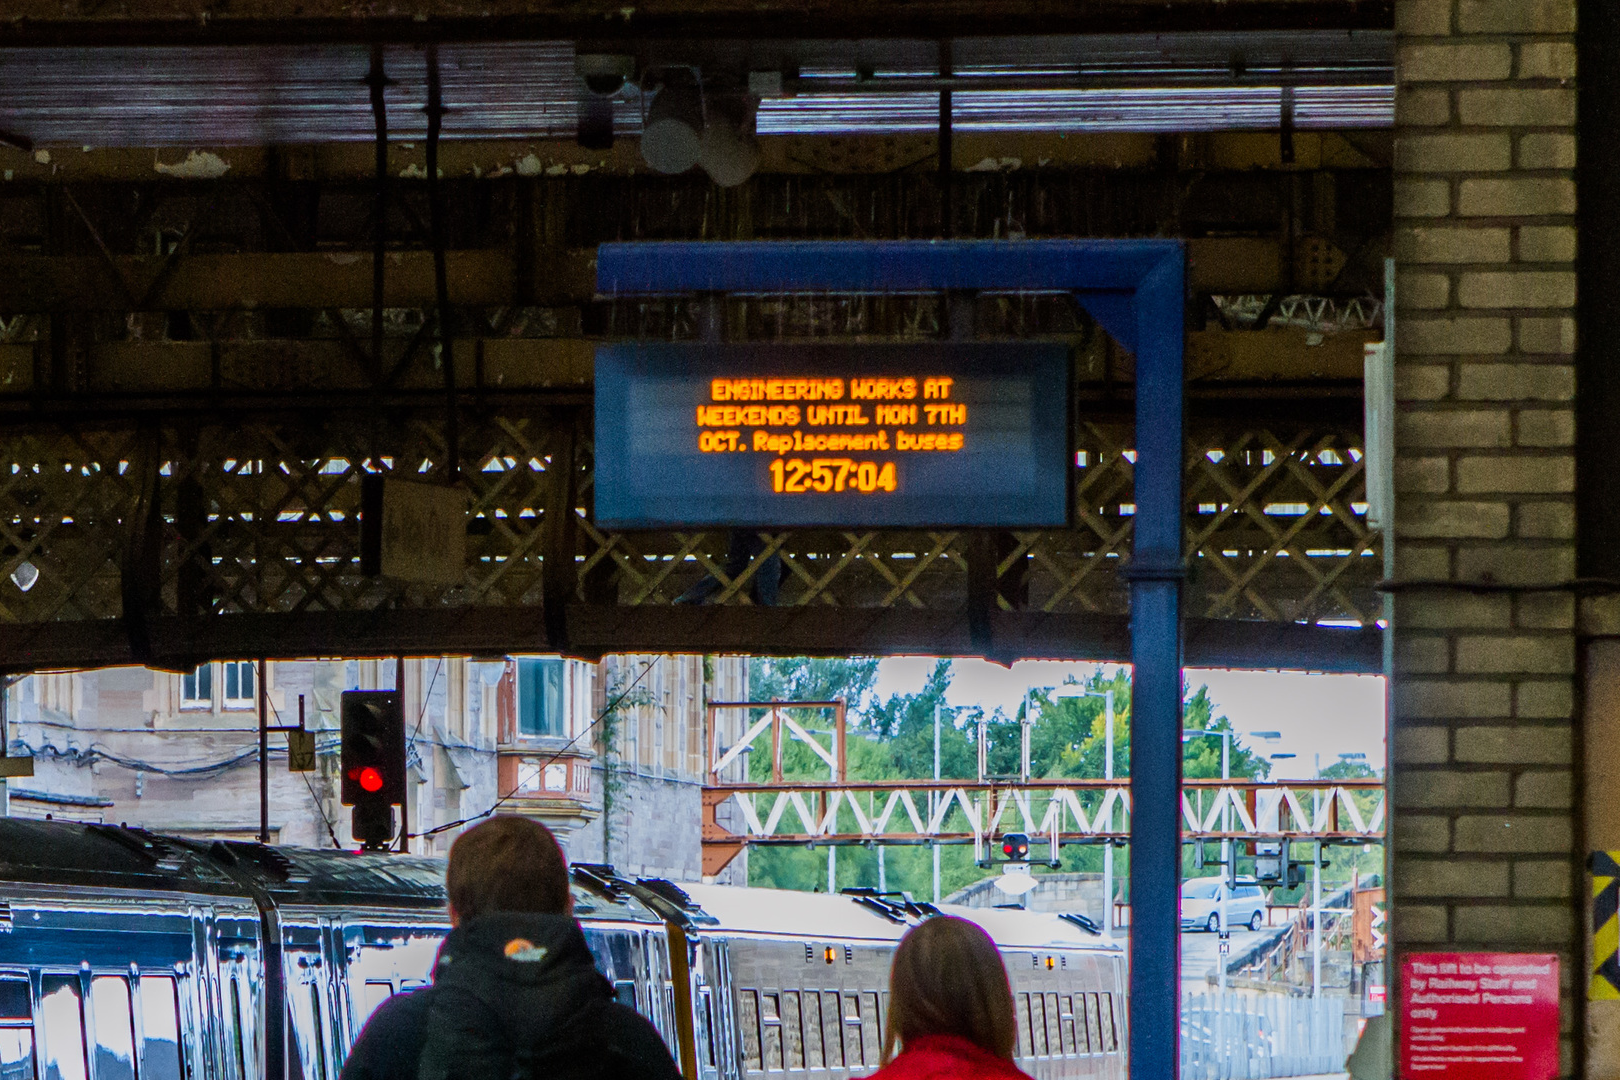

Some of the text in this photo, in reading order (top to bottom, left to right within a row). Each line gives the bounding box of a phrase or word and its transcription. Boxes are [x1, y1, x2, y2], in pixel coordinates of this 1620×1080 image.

[712, 378, 953, 400] ENGINEERING WORKS AT
[696, 404, 966, 426] WEEKENDS UNTIL MON 7TH
[699, 430, 963, 455] OCT. Replacement buses
[771, 459, 897, 493] 12:57:04
